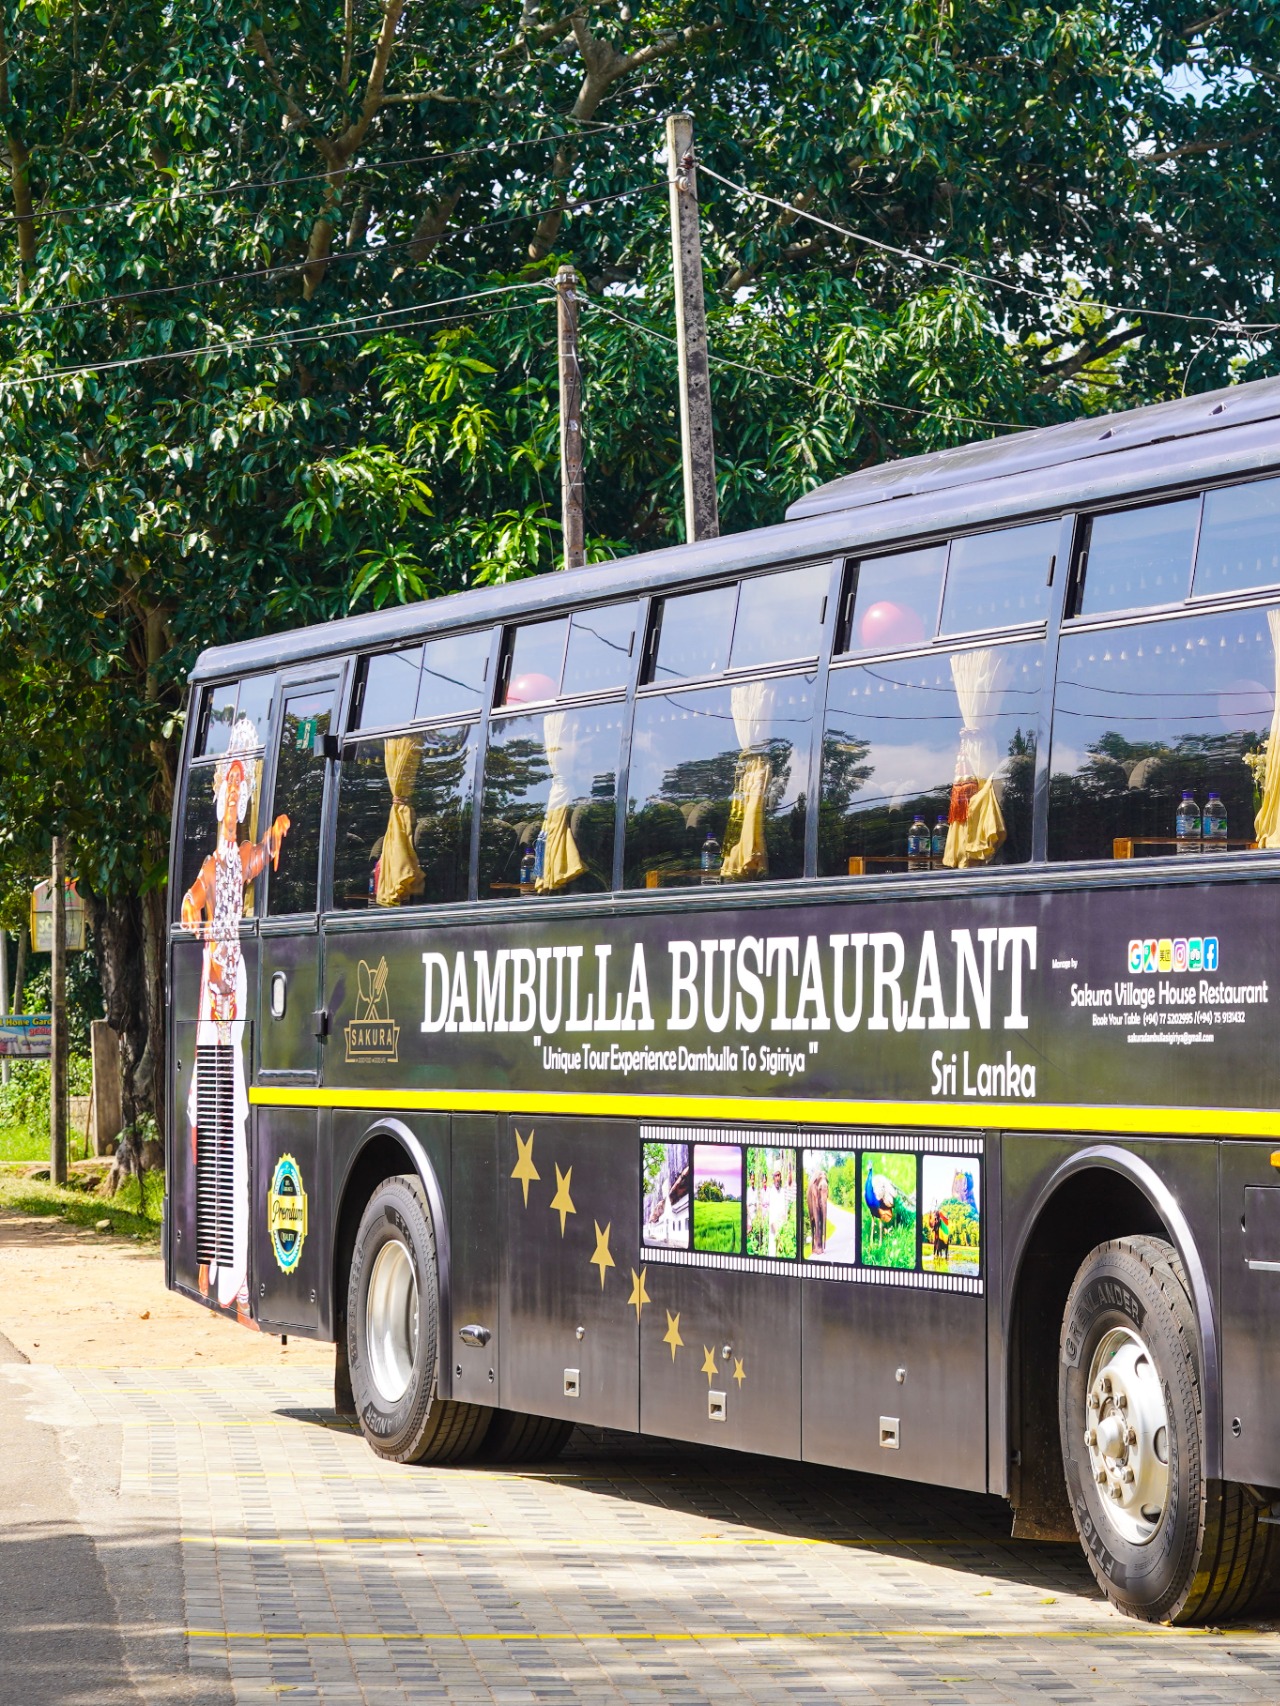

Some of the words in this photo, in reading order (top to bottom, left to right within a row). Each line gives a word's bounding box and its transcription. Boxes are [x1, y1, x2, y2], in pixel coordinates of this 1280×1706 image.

[420, 942, 655, 1034] DAMBULLA
[667, 926, 1037, 1034] BUSTAURANT
[1071, 983, 1112, 1007] Sakura
[1115, 981, 1155, 1009] Village
[1159, 981, 1196, 1005] House
[1199, 980, 1269, 1004] Restaurant
[6, 1018, 29, 1026] Home
[1092, 1013, 1108, 1026] Book
[1108, 1013, 1124, 1026] Your
[1124, 1012, 1140, 1025] Table
[1143, 1011, 1158, 1027] (+94)
[1159, 1012, 1167, 1025] 77
[351, 1028, 392, 1046] SAKURA
[543, 1046, 581, 1075] Unique
[582, 1043, 610, 1071] Tour
[611, 1043, 677, 1076] Experience
[678, 1045, 737, 1072] Dambulla
[740, 1046, 756, 1072] To
[759, 1045, 805, 1077] Sigiriya
[931, 1050, 957, 1096] Sri
[963, 1050, 1036, 1098] Lanka
[272, 1199, 303, 1223] Premium
